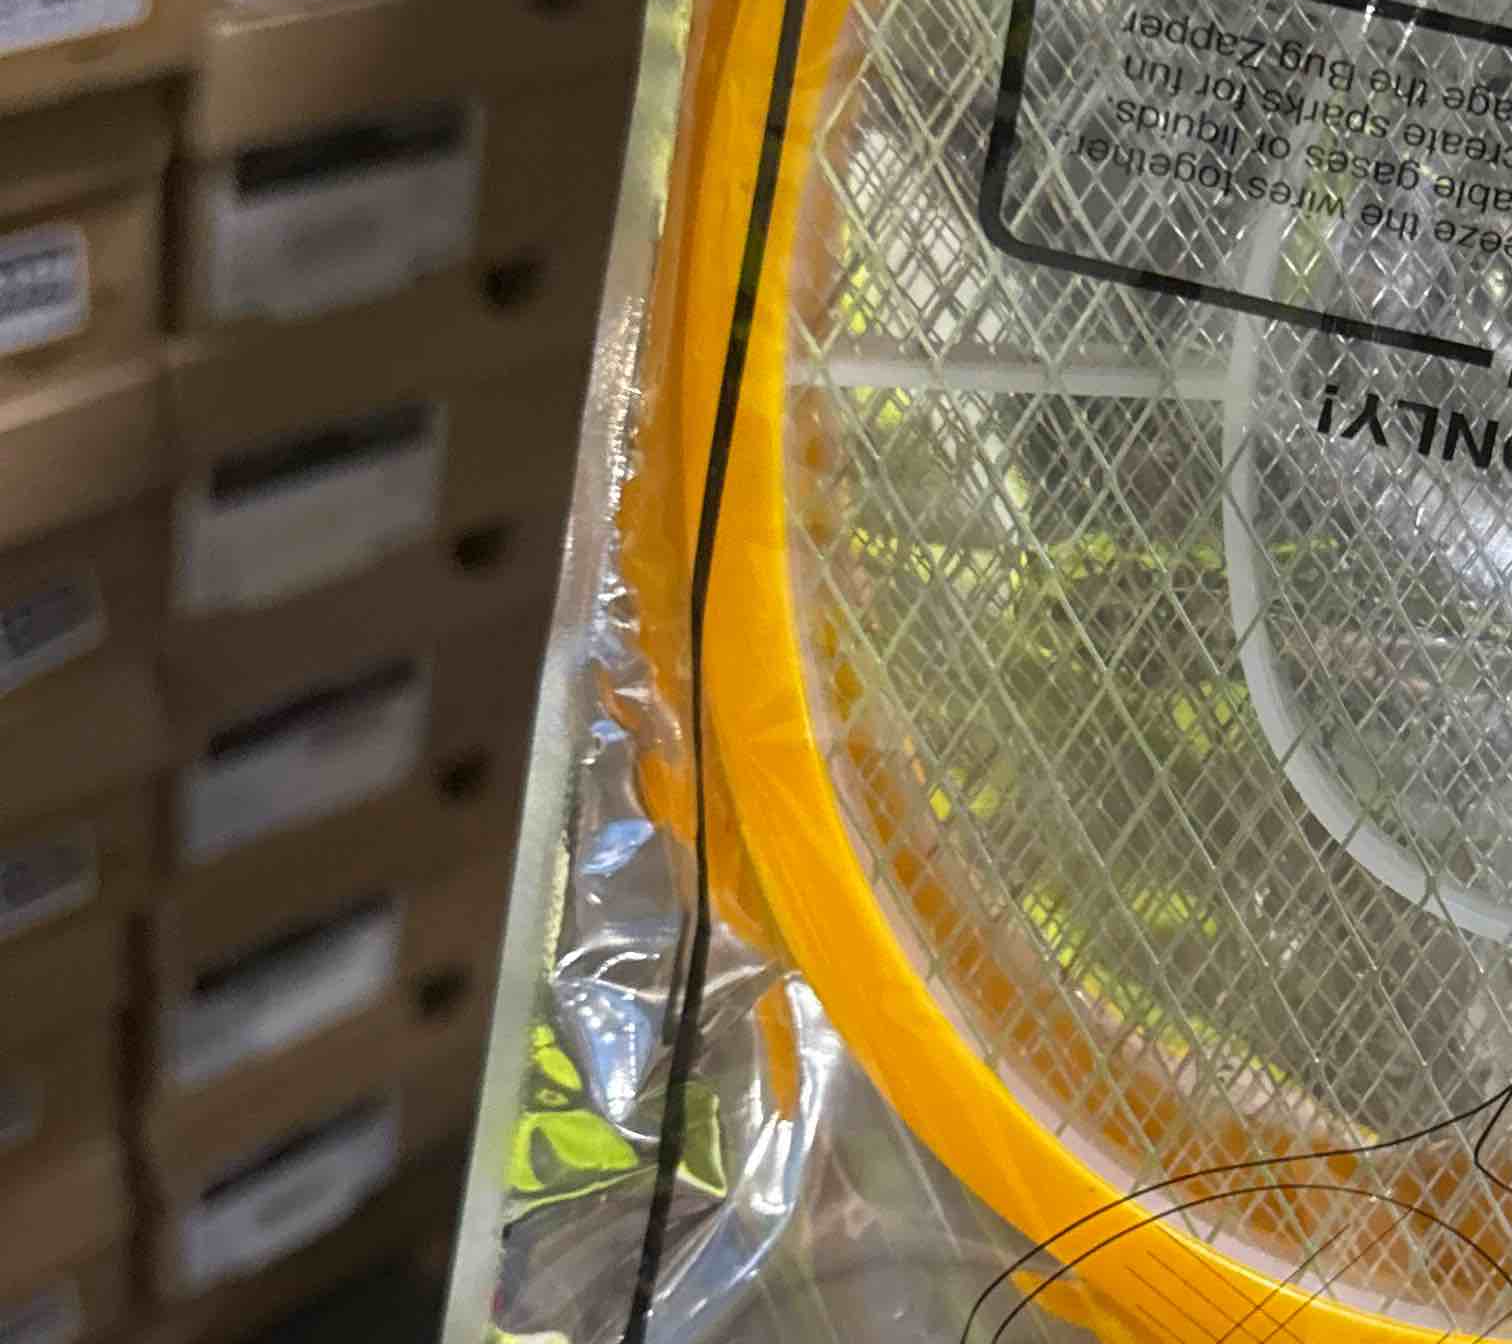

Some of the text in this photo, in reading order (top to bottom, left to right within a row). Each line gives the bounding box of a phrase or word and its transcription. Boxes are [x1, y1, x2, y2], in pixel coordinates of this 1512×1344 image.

[1119, 6, 1266, 69] Zapper
[1276, 37, 1358, 89] Bug
[1120, 53, 1186, 96] fun
[1191, 71, 1248, 109] for
[1366, 67, 1429, 106] the
[1100, 88, 1242, 155] liquids.
[1258, 80, 1393, 143] sparks
[1246, 130, 1290, 162] or
[1302, 136, 1421, 192] gases
[1229, 170, 1349, 225] wires
[1358, 200, 1420, 241] the
